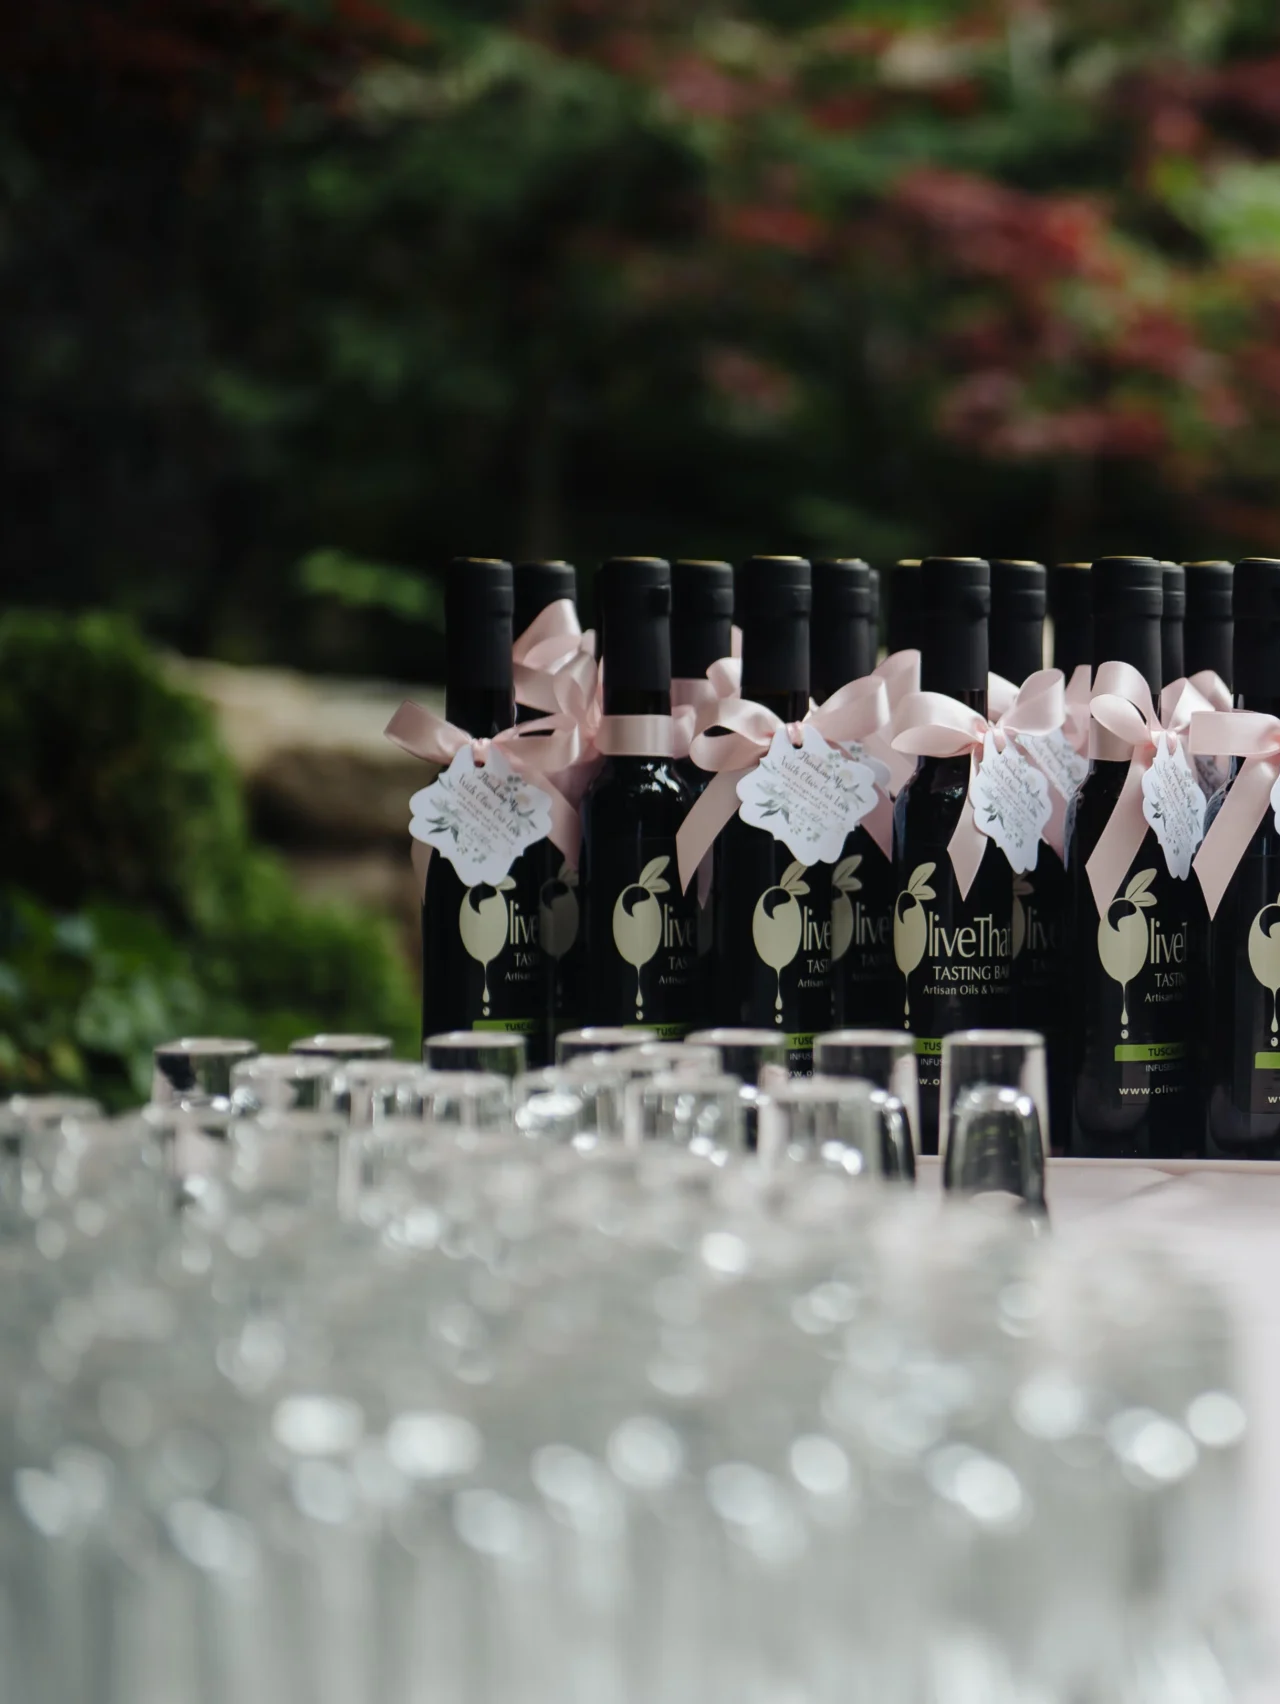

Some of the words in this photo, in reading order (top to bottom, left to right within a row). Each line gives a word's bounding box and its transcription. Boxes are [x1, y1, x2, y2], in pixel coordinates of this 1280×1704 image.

[798, 750, 832, 784] Thanking
[932, 966, 991, 981] TASTING
[922, 984, 957, 995] Artisan
[960, 984, 979, 995] Oils
[981, 984, 988, 995] &
